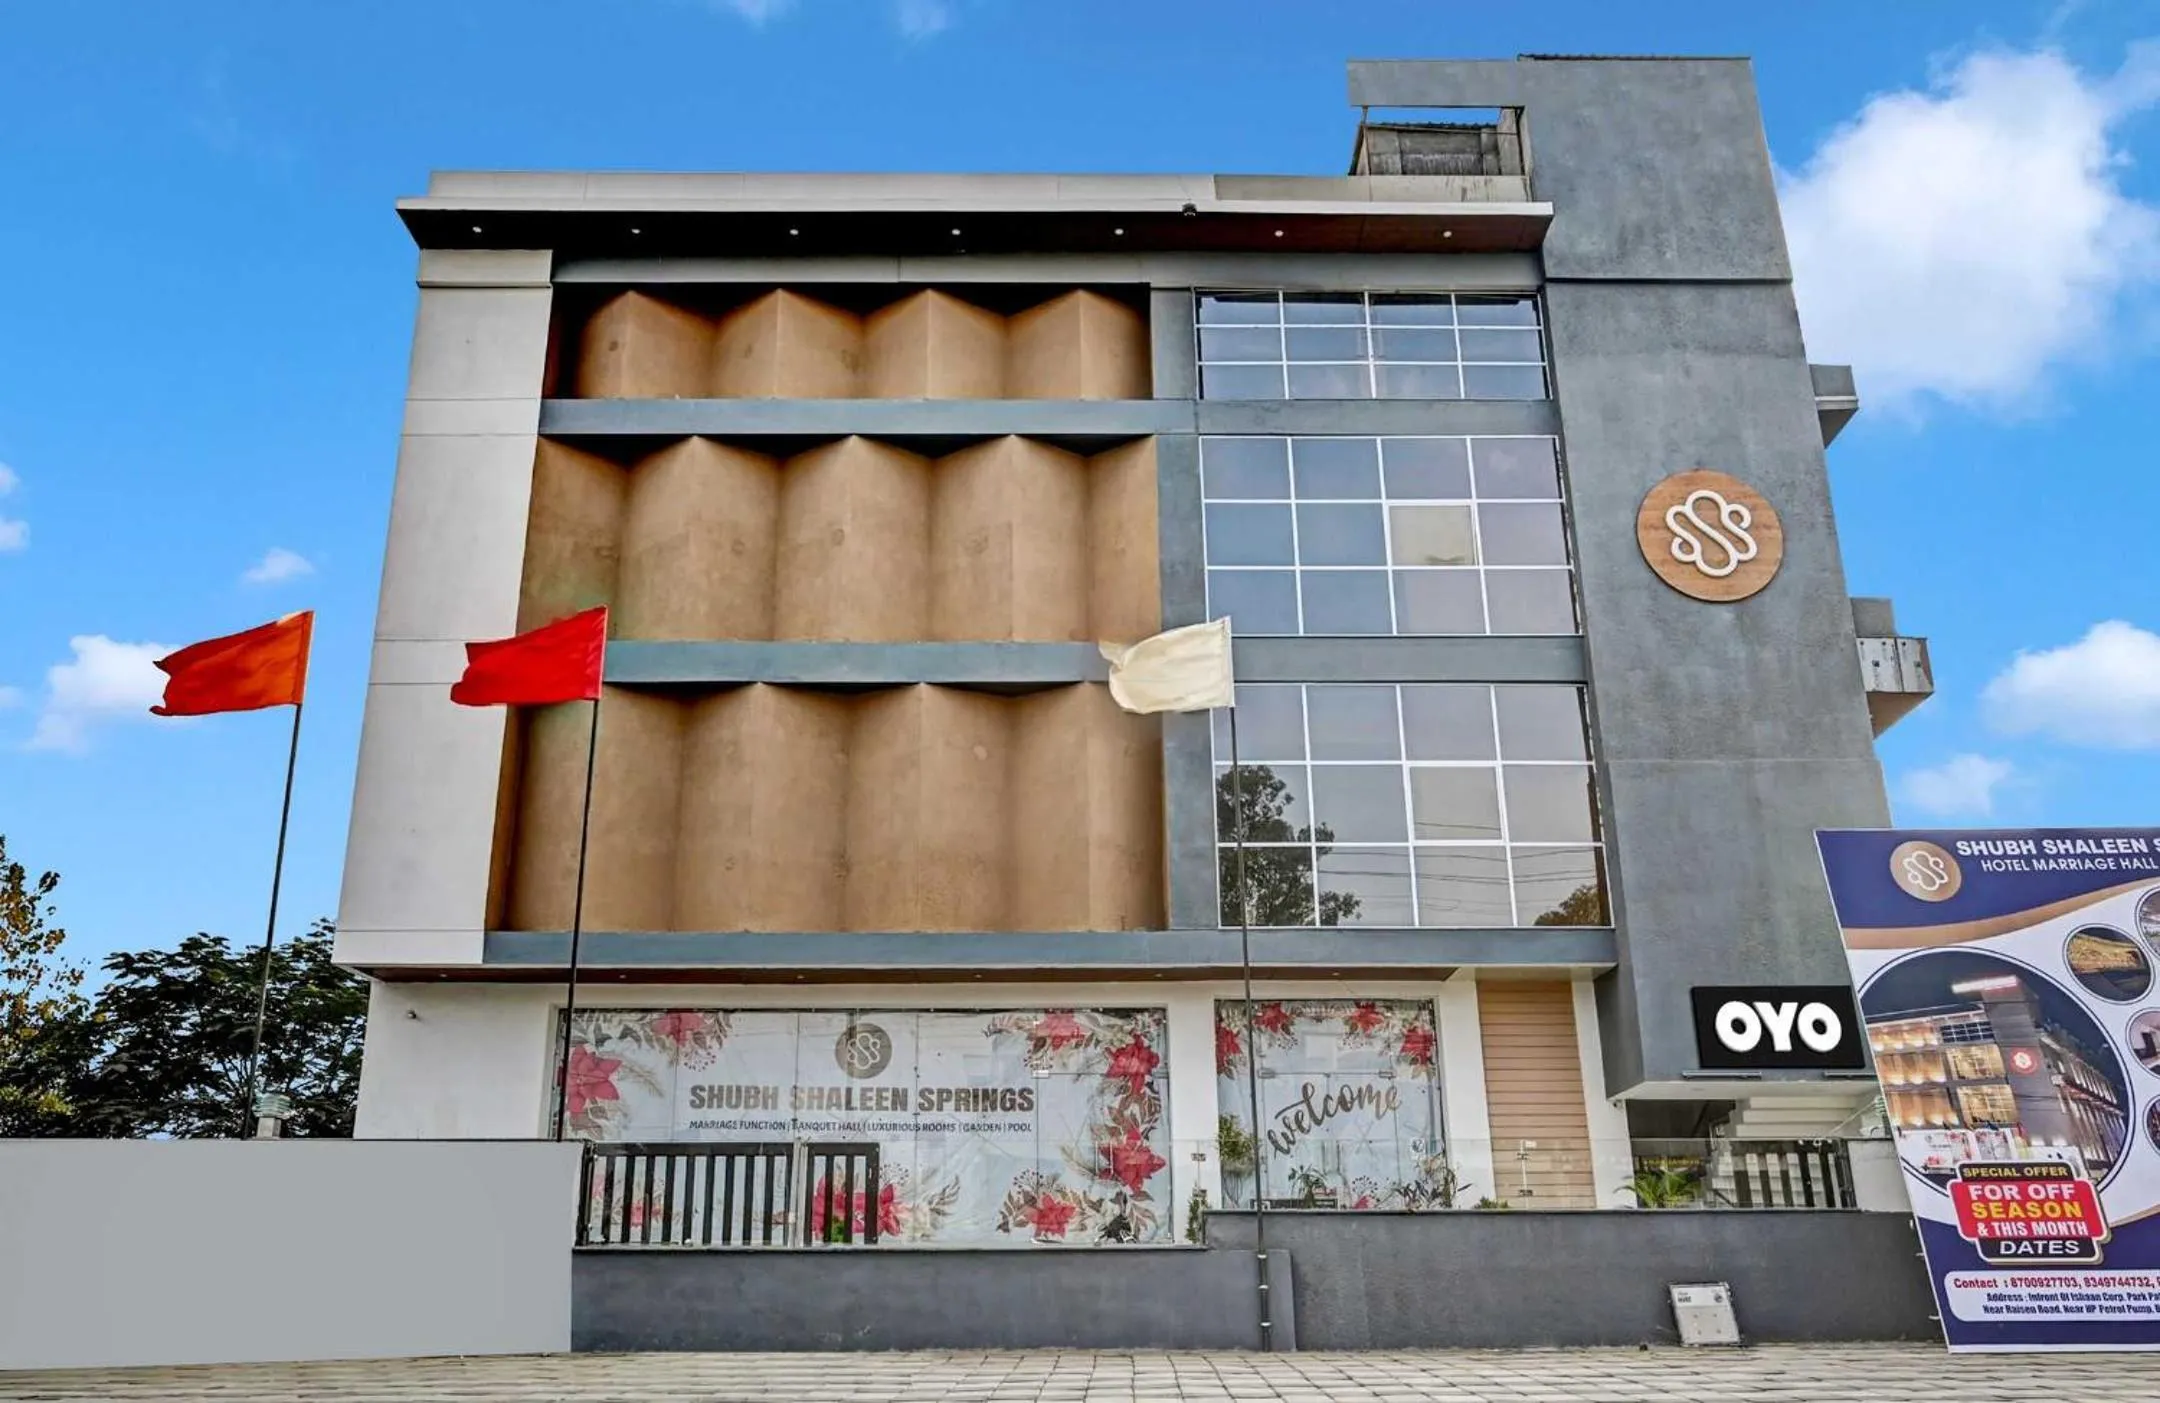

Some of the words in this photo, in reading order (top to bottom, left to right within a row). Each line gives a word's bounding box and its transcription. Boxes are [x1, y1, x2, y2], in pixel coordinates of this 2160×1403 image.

[1956, 839, 2037, 856] SHUBH
[2042, 838, 2149, 855] SHALEEN
[1981, 859, 2030, 872] HOTEL
[2033, 858, 2118, 872] MARRIAGE
[2120, 857, 2159, 870] HALL
[1715, 1000, 1842, 1052] OYO
[689, 1084, 779, 1110] SHUBH
[790, 1086, 908, 1112] SHALEEN
[918, 1087, 1034, 1113] SPRINGS
[689, 1120, 738, 1130] MARRIAGE
[739, 1121, 786, 1131] FUNCTION
[867, 1122, 920, 1132] LUXURIOUS
[922, 1122, 956, 1132] ROOMS
[962, 1122, 1004, 1132] GARDEN
[1007, 1122, 1032, 1132] POOL
[1267, 1082, 1402, 1160] welcome
[1963, 1167, 2022, 1178] SPECIAL
[2023, 1166, 2068, 1177] OFFER
[1968, 1184, 2022, 1201] FOR
[2027, 1183, 2076, 1200] OFF
[1971, 1201, 2083, 1219] SEASON
[1977, 1222, 1989, 1237] &
[1991, 1222, 2029, 1237] THIS
[2031, 1221, 2089, 1237] MONTH
[2000, 1240, 2080, 1255] DATES
[1953, 1278, 1999, 1289] Contact
